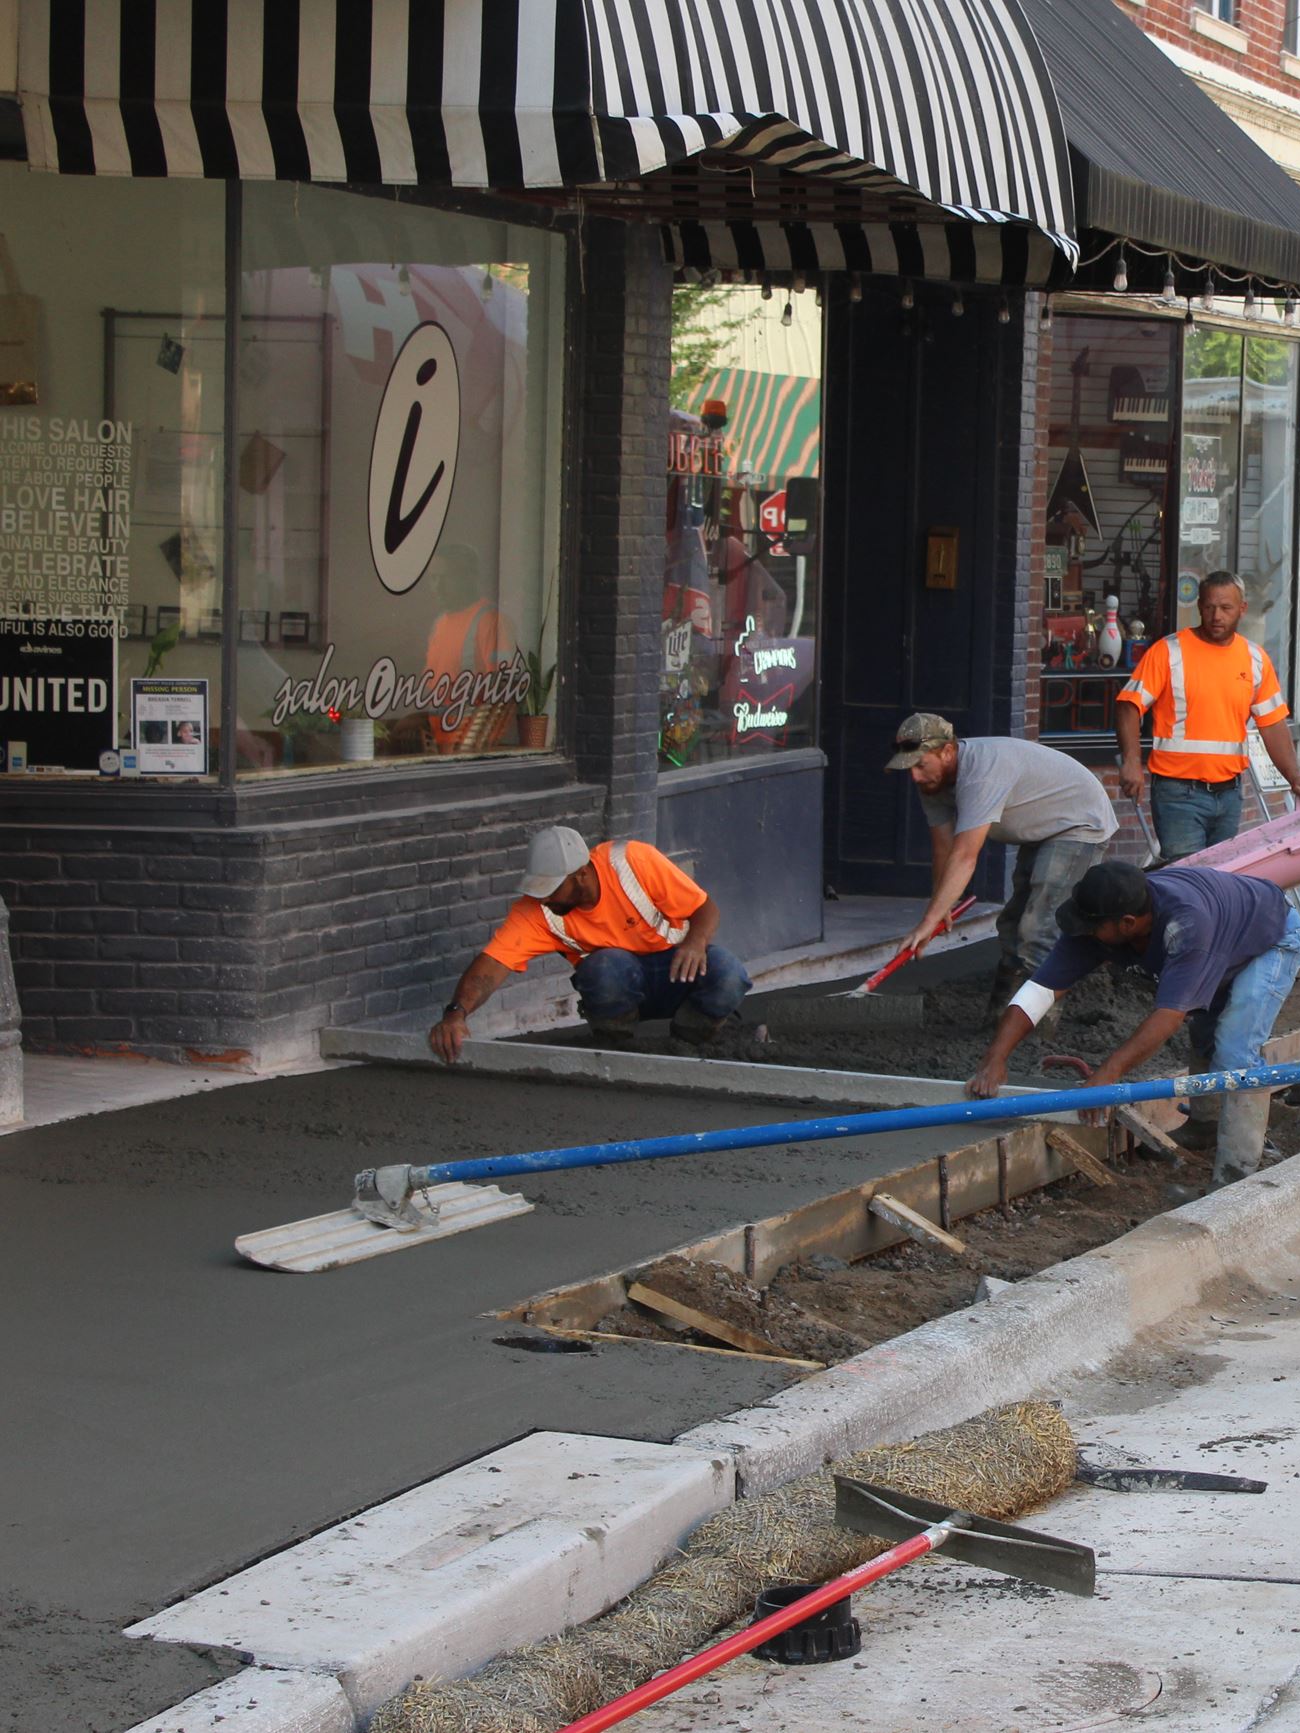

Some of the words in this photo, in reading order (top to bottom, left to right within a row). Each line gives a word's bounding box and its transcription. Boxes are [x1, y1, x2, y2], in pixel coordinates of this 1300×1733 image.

[0, 417, 41, 440] HIS
[49, 418, 132, 444] SALON
[49, 443, 76, 456] OUR
[80, 444, 131, 458] GUESTS
[35, 456, 52, 470] TO
[57, 457, 130, 473] REQUESTS
[24, 471, 71, 486] ABOUT
[76, 473, 130, 488] PEOPLE
[2, 486, 66, 510] LOVE
[74, 488, 130, 513] HAIR
[2, 509, 100, 536] BELIEVE
[108, 513, 129, 538] IN
[67, 538, 129, 554] BEAUTY
[0, 552, 129, 578] CELEBRATE
[12, 575, 43, 590] AND
[48, 576, 129, 592] ELEGANCE
[48, 592, 129, 605] SUGGESTIONS
[79, 604, 128, 624] THAT
[33, 622, 45, 636] IS
[48, 624, 84, 637] ALSO
[88, 625, 128, 638] GOOD
[273, 643, 363, 725] salon
